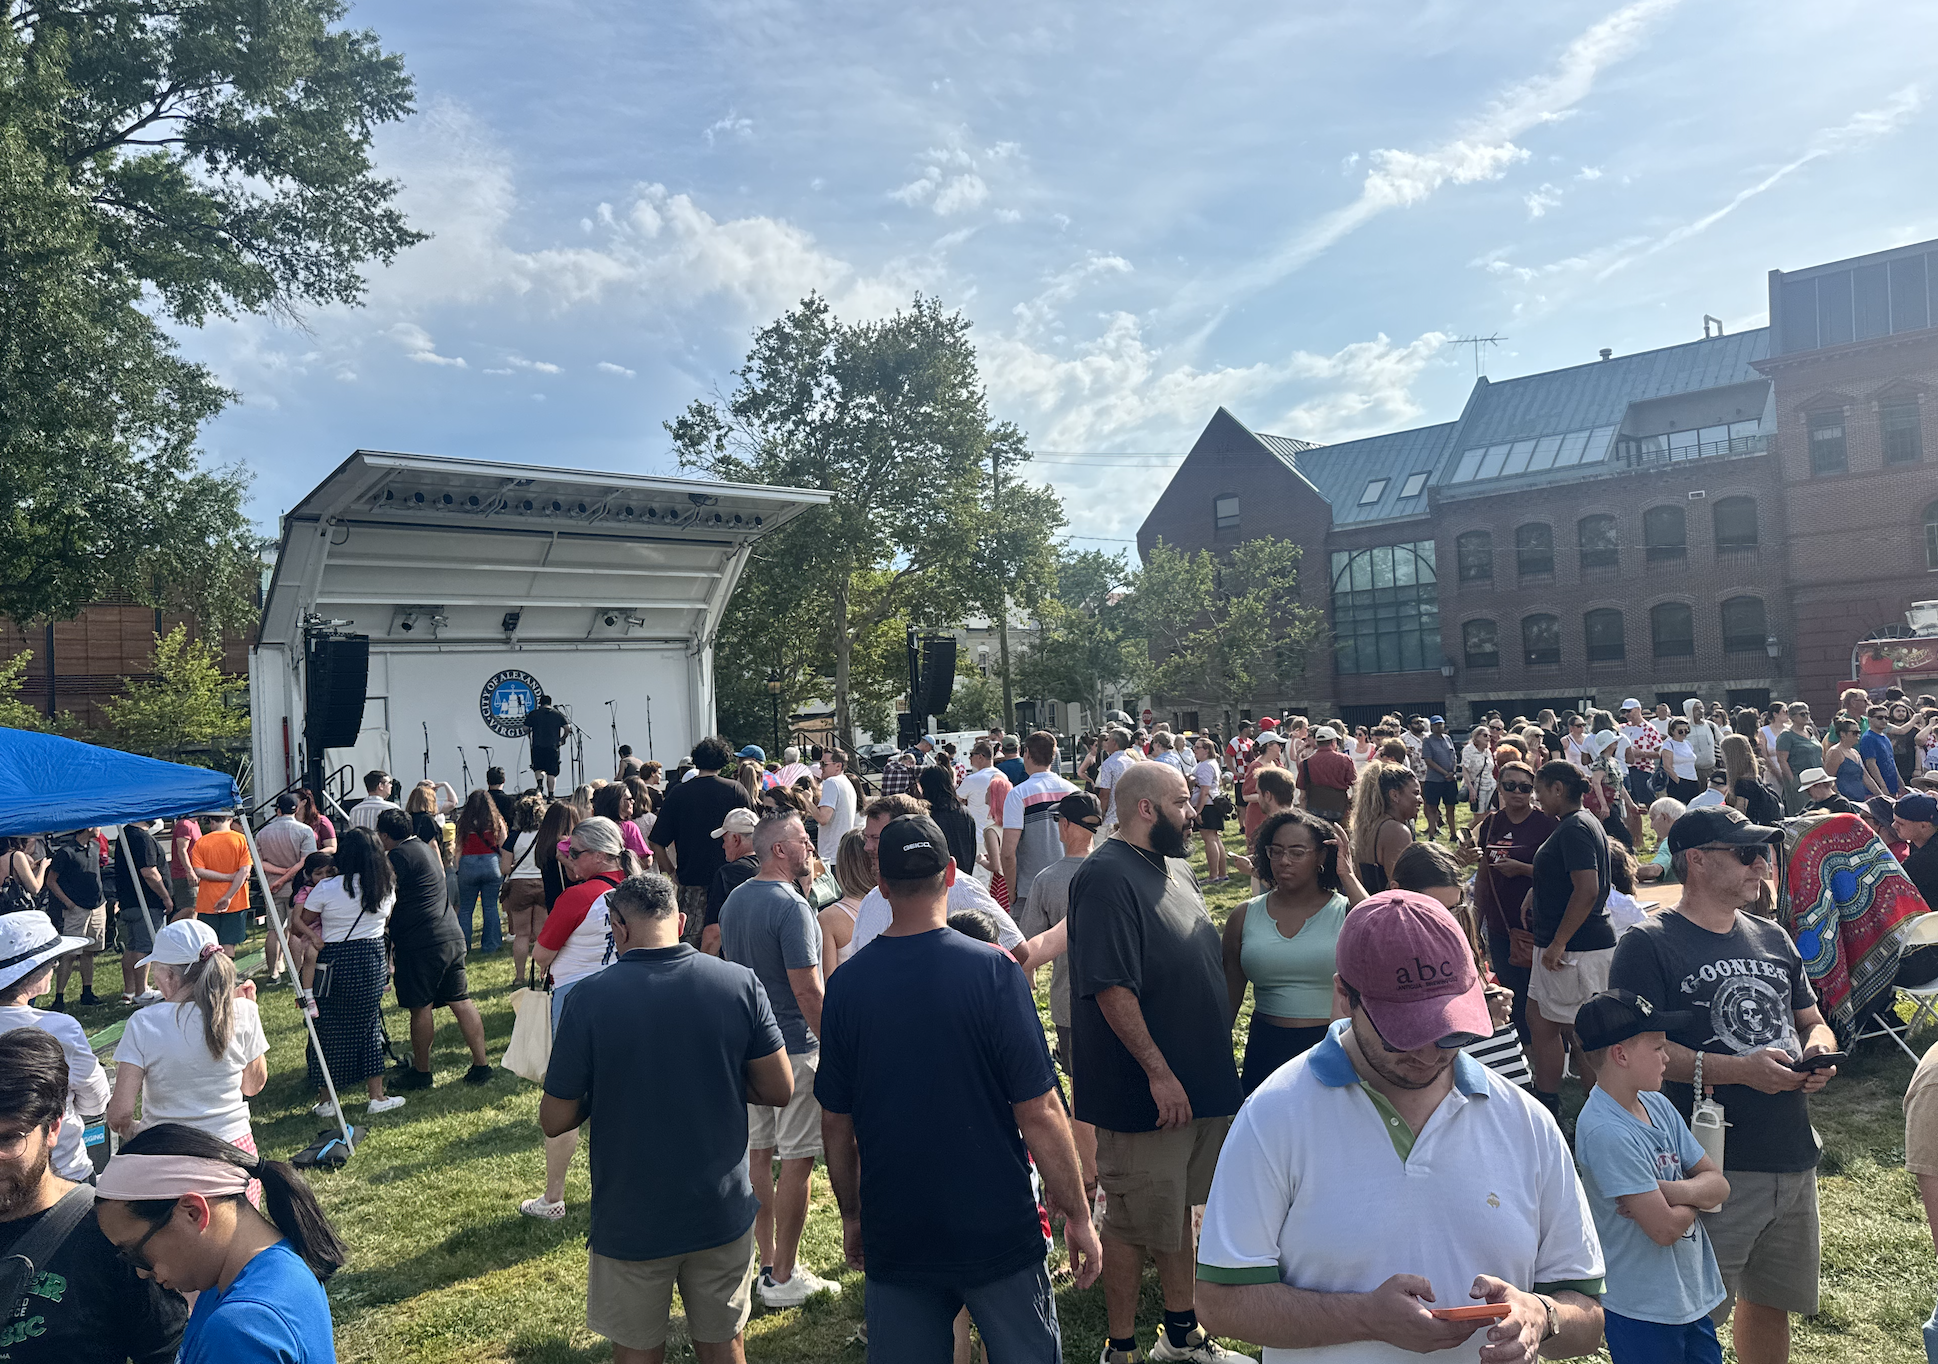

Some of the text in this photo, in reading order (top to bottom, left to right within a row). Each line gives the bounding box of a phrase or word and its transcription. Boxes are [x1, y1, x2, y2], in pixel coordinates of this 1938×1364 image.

[482, 692, 490, 717] CITY
[487, 678, 500, 691] OF
[903, 841, 931, 852] GEICO
[1680, 959, 1789, 994] GOONIES
